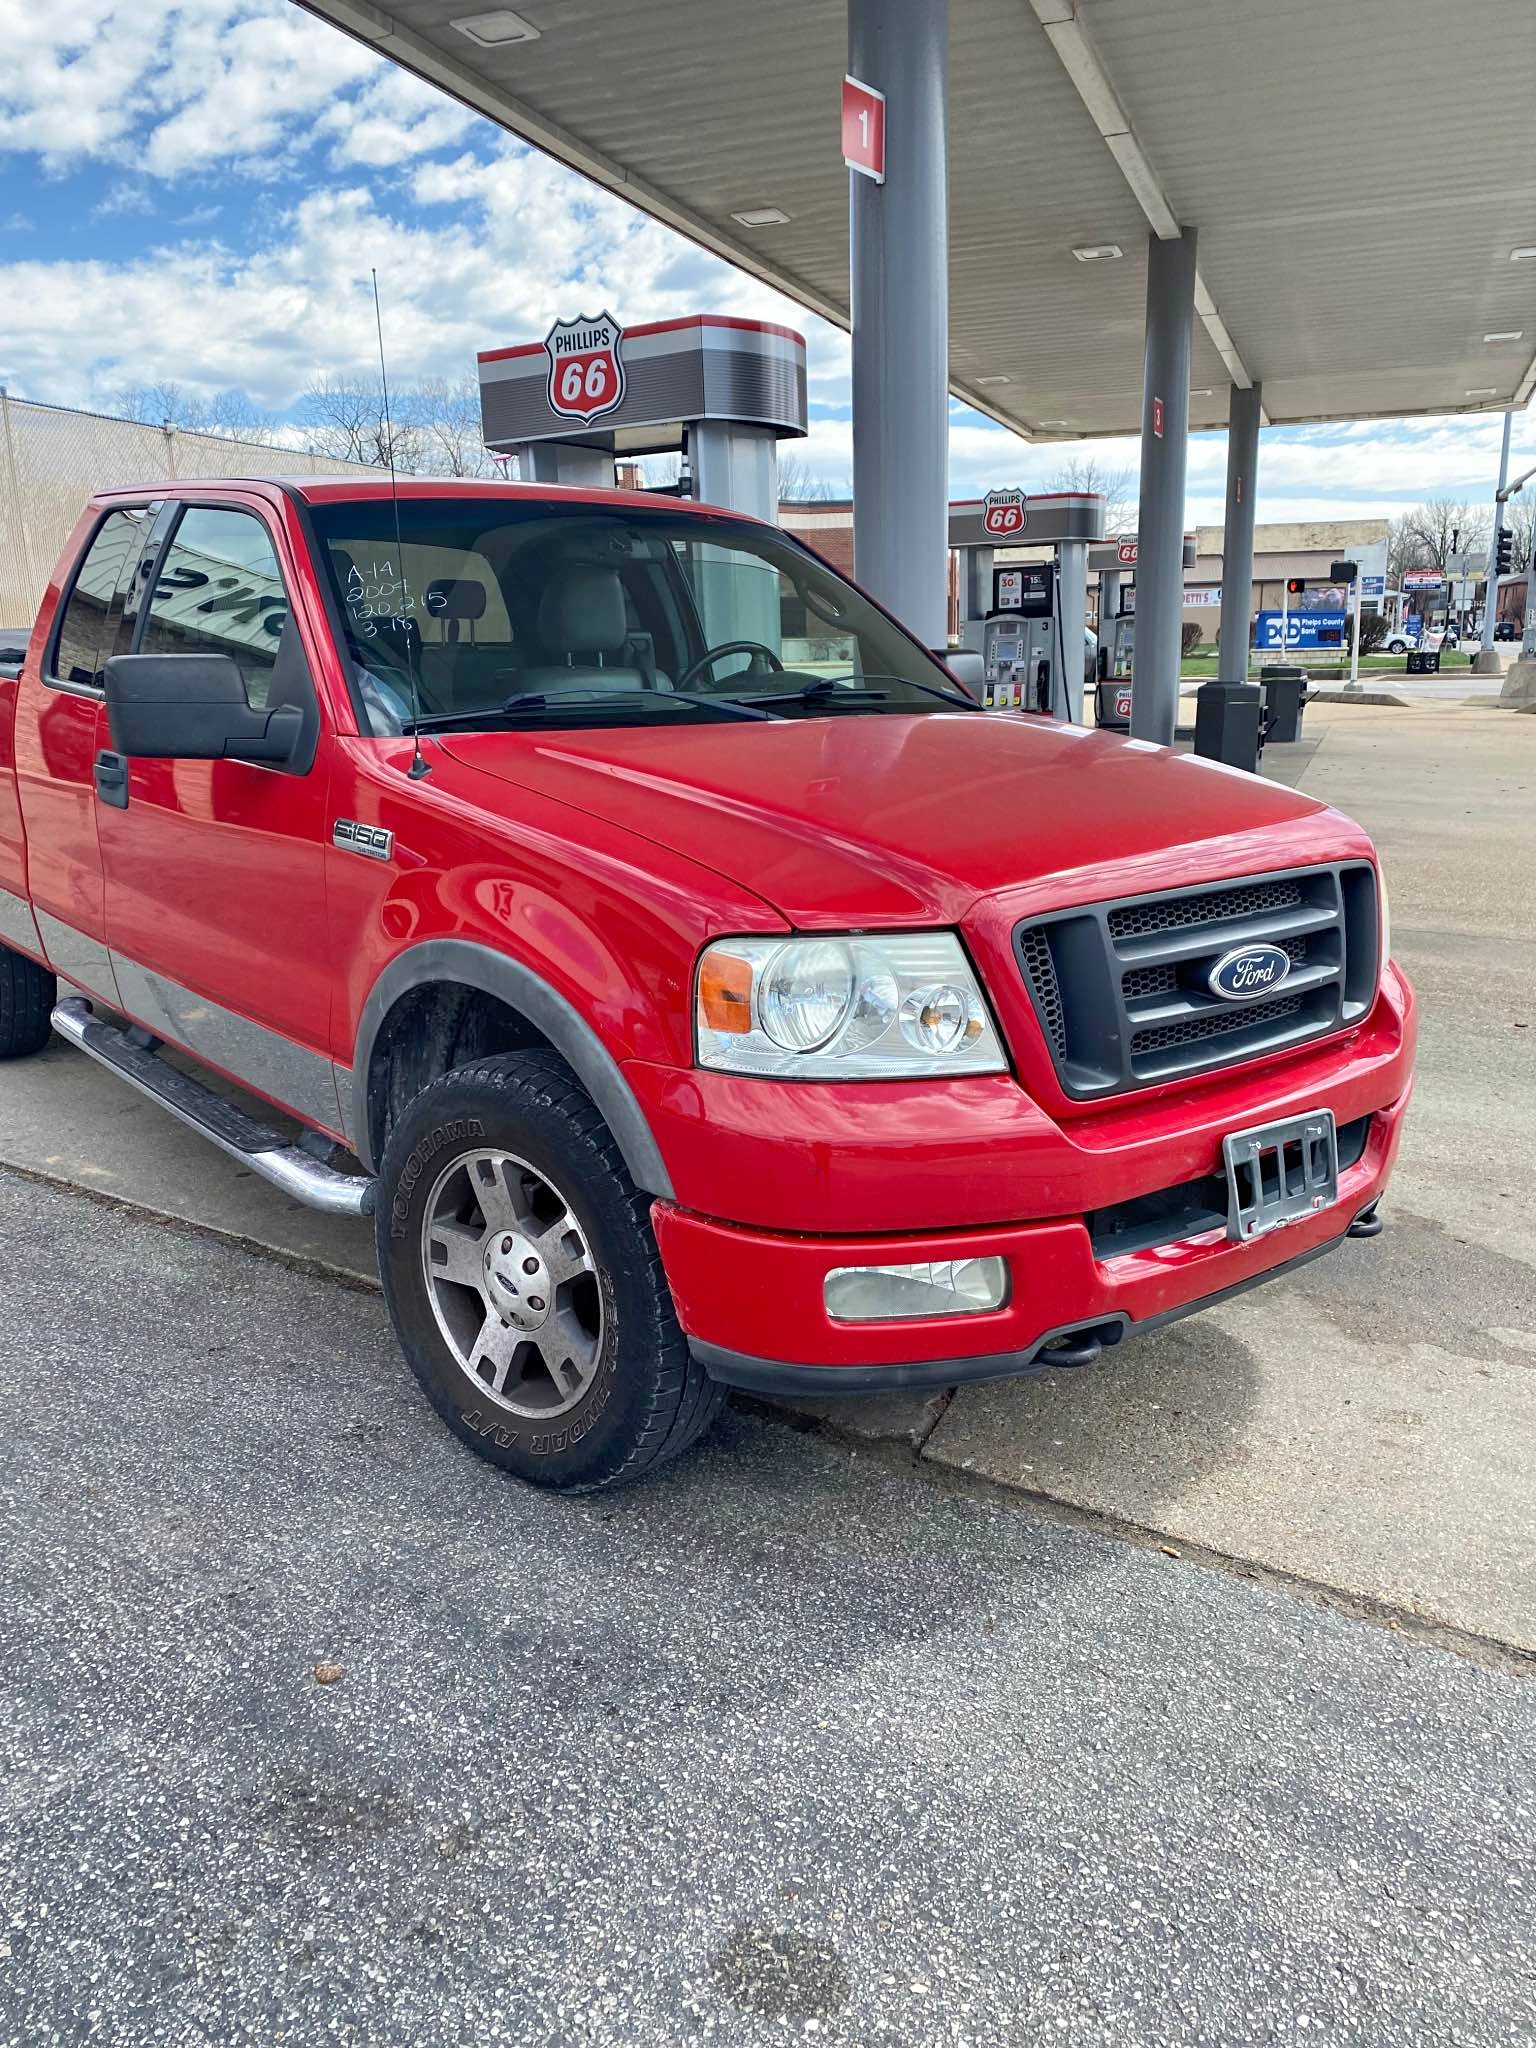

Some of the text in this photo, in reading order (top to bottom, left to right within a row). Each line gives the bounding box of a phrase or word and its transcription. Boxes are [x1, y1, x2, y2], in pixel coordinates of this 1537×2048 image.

[858, 109, 868, 149] 1
[555, 326, 610, 353] PHILLIPS
[560, 357, 608, 402] 66
[989, 494, 1020, 505] PHILLIPS
[990, 508, 1018, 529] 66
[1042, 622, 1049, 631] 3
[1301, 618, 1345, 627] Phelps County
[1301, 627, 1316, 635] Bank
[1120, 700, 1131, 713] 6
[1232, 955, 1275, 989] Ford
[391, 1118, 486, 1239] YOKOHAMA
[460, 1409, 519, 1449] A/T
